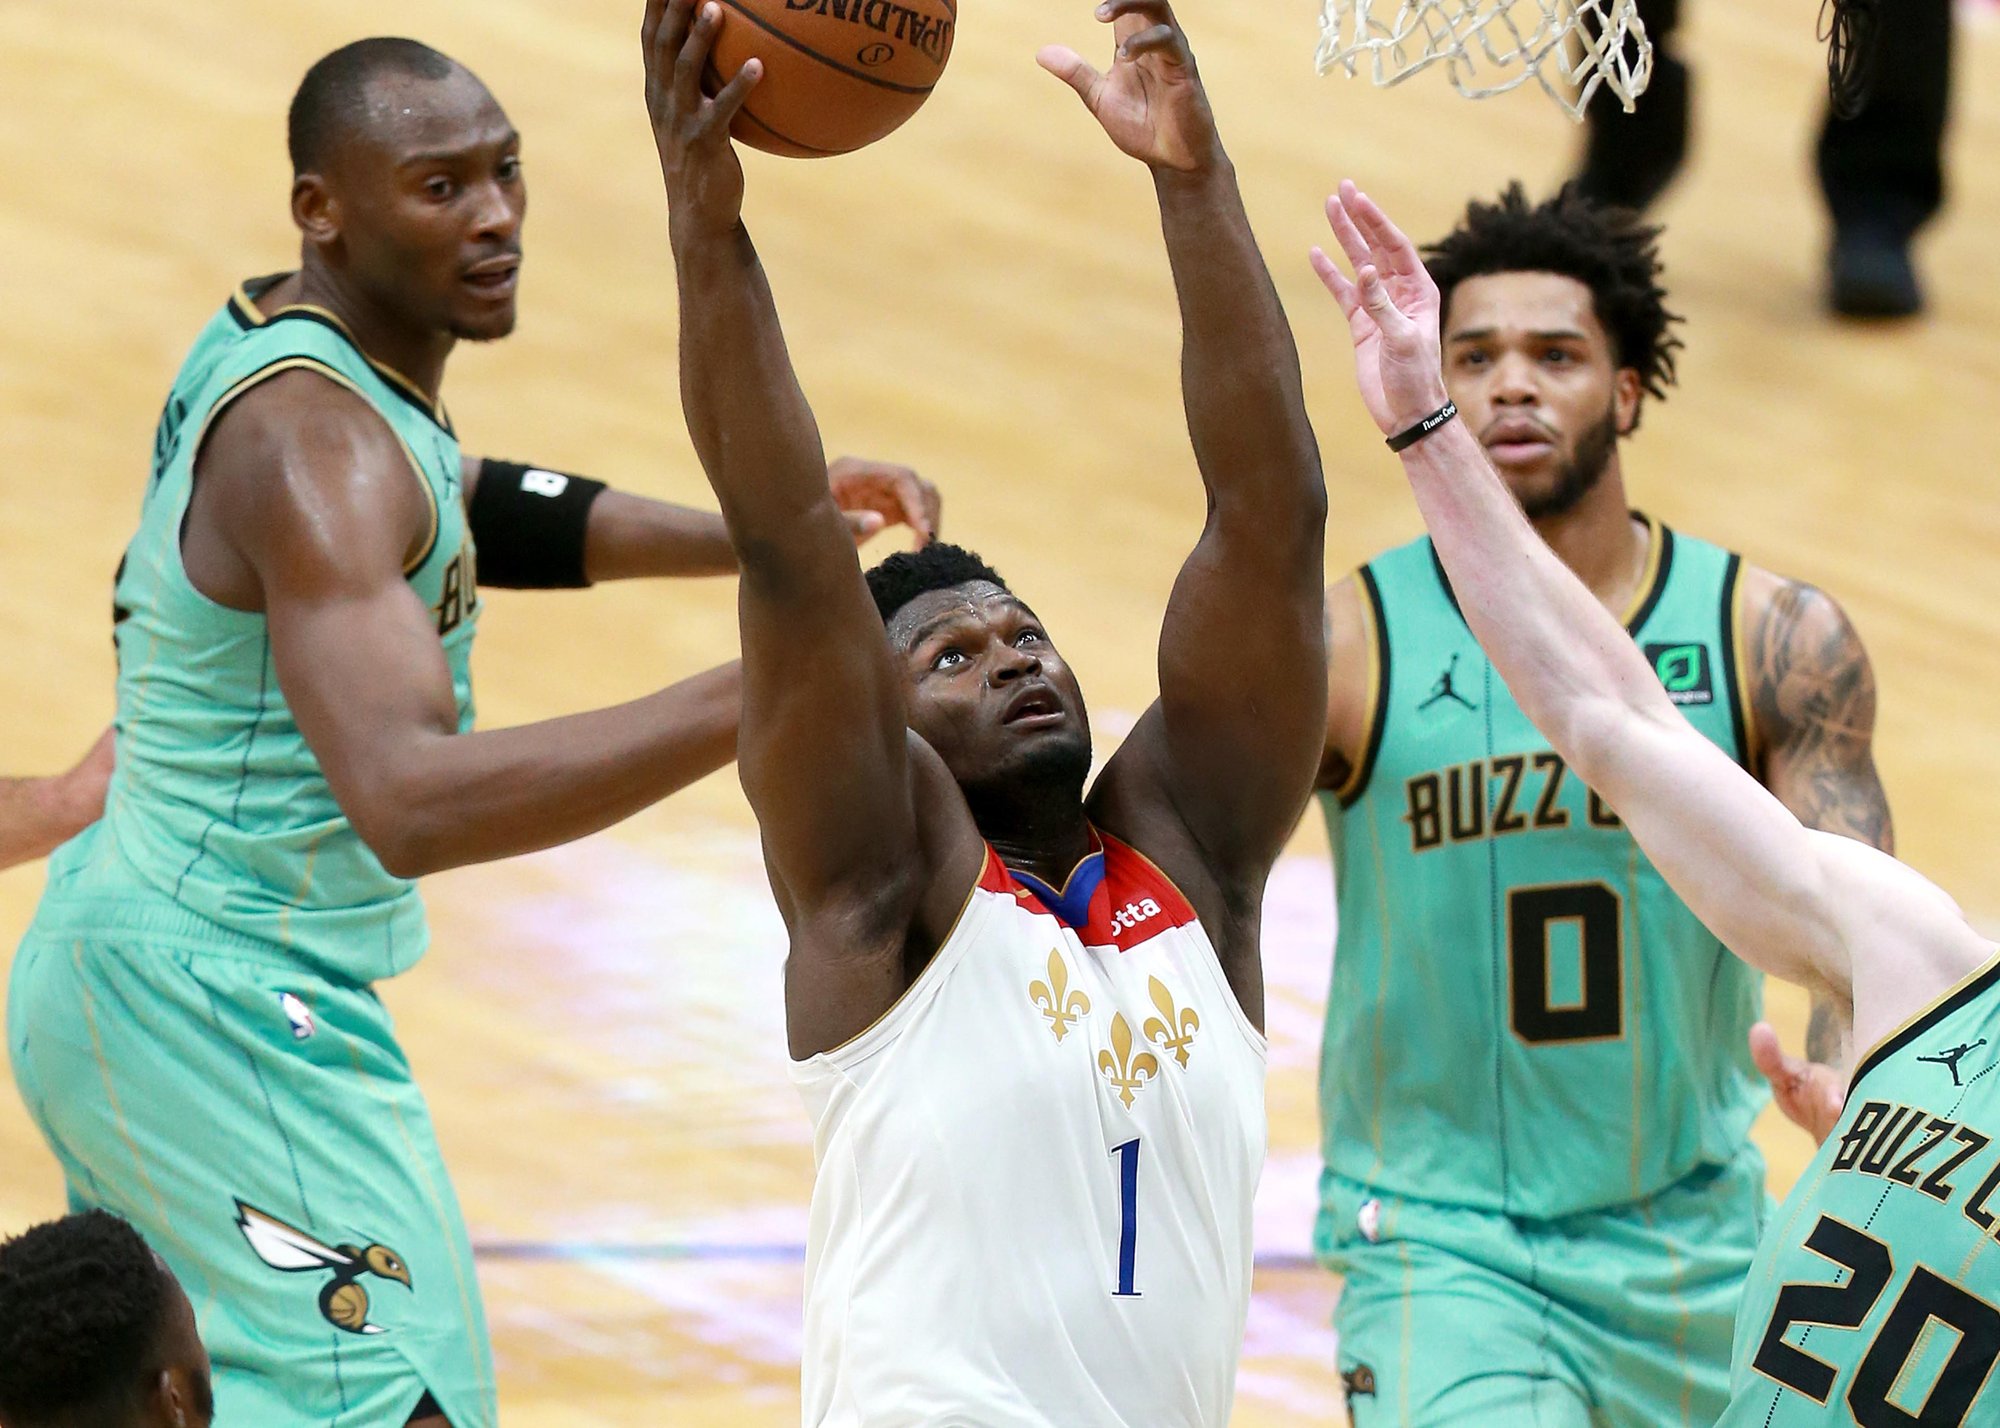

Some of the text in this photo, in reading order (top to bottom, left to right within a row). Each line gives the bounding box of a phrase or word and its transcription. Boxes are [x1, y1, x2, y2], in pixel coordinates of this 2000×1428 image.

[1402, 751, 1570, 855] BUZZ
[1505, 880, 1625, 1048] 0
[1109, 1137, 1144, 1298] 1
[1829, 1100, 1993, 1204] BUZZ
[1752, 1211, 2000, 1428] 20
